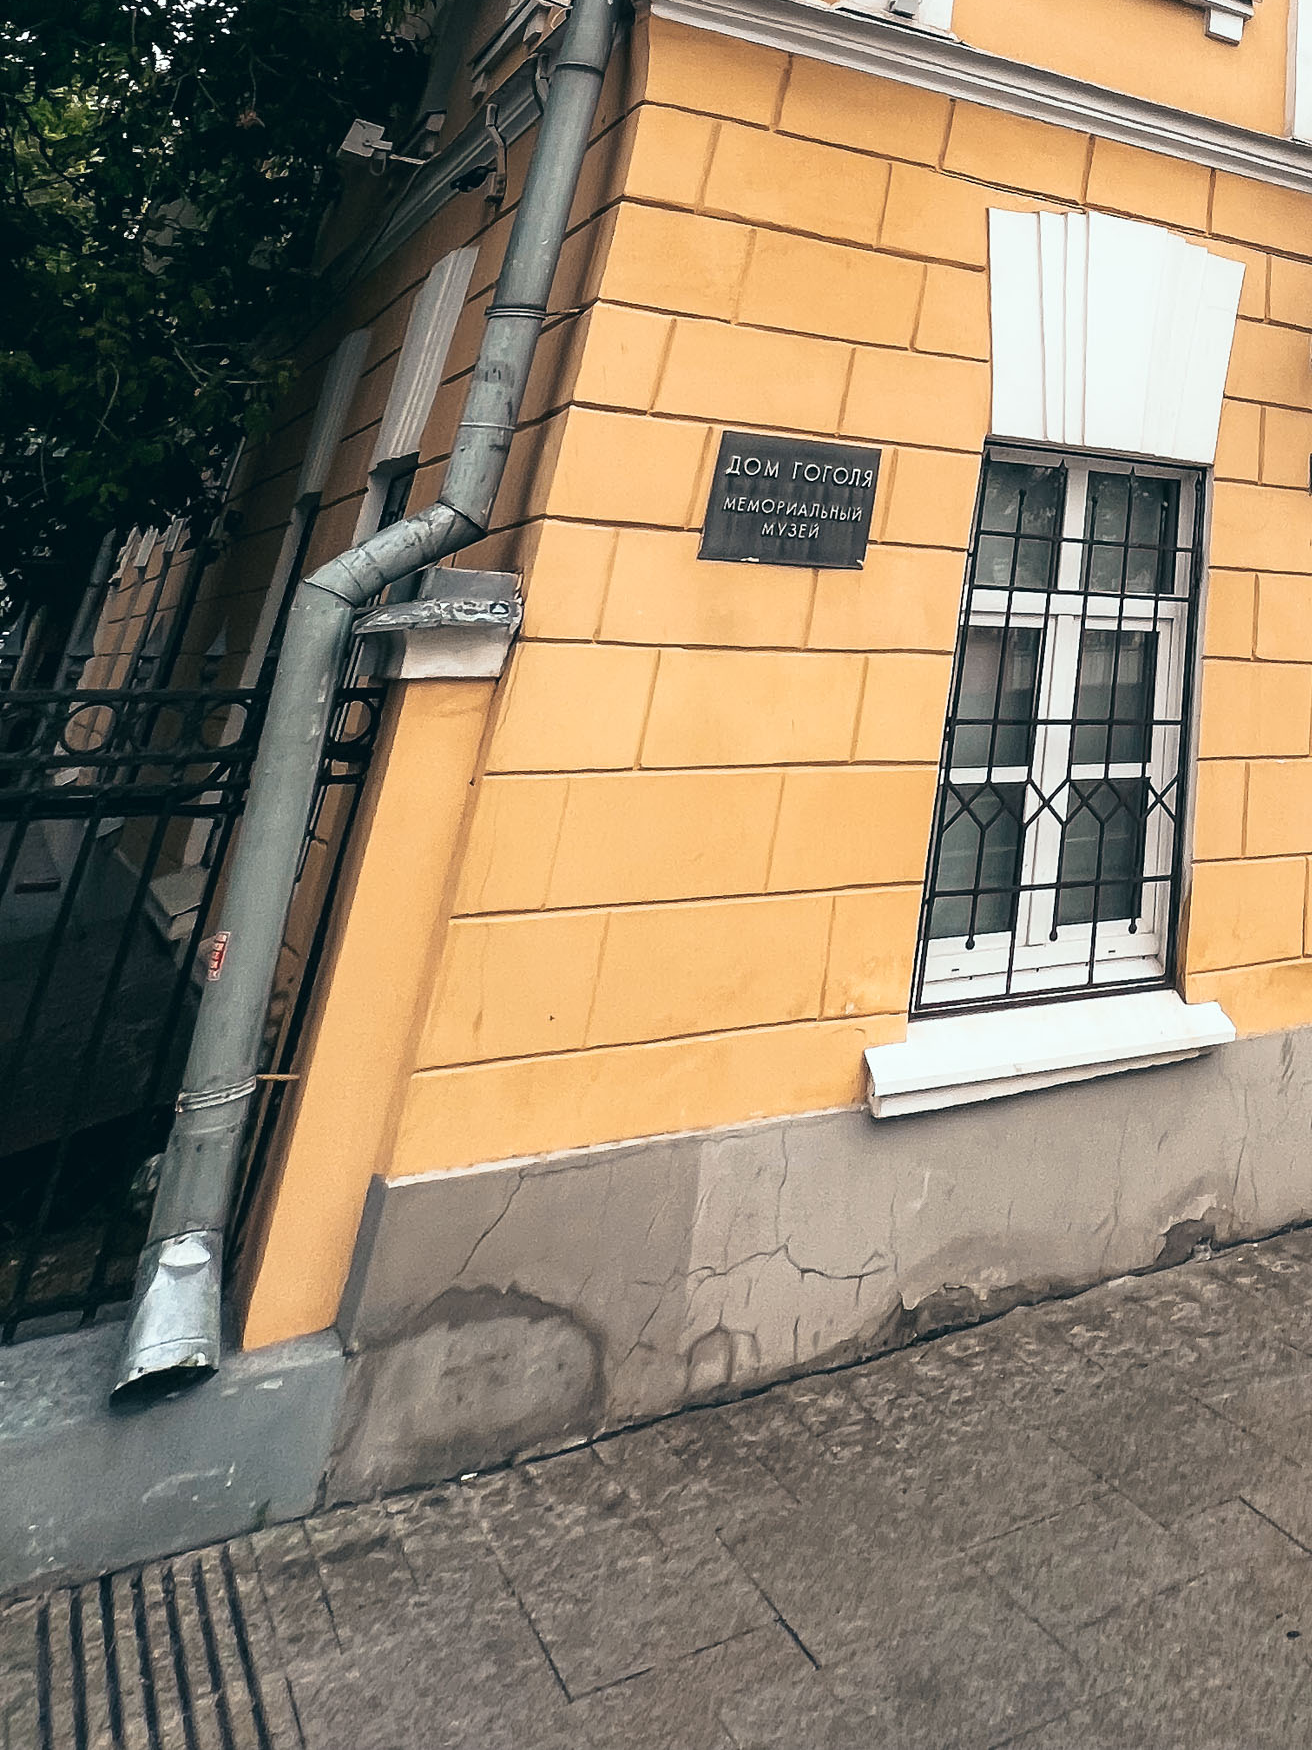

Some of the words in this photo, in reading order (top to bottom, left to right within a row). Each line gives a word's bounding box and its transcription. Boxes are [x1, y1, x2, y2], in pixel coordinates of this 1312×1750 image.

[725, 455, 780, 479] ДОМ
[792, 461, 873, 488] ГОГОЛЯ
[723, 497, 863, 522] МЕМОРИАЛЬНЫЙ
[761, 522, 820, 539] МУЗЕЙ
